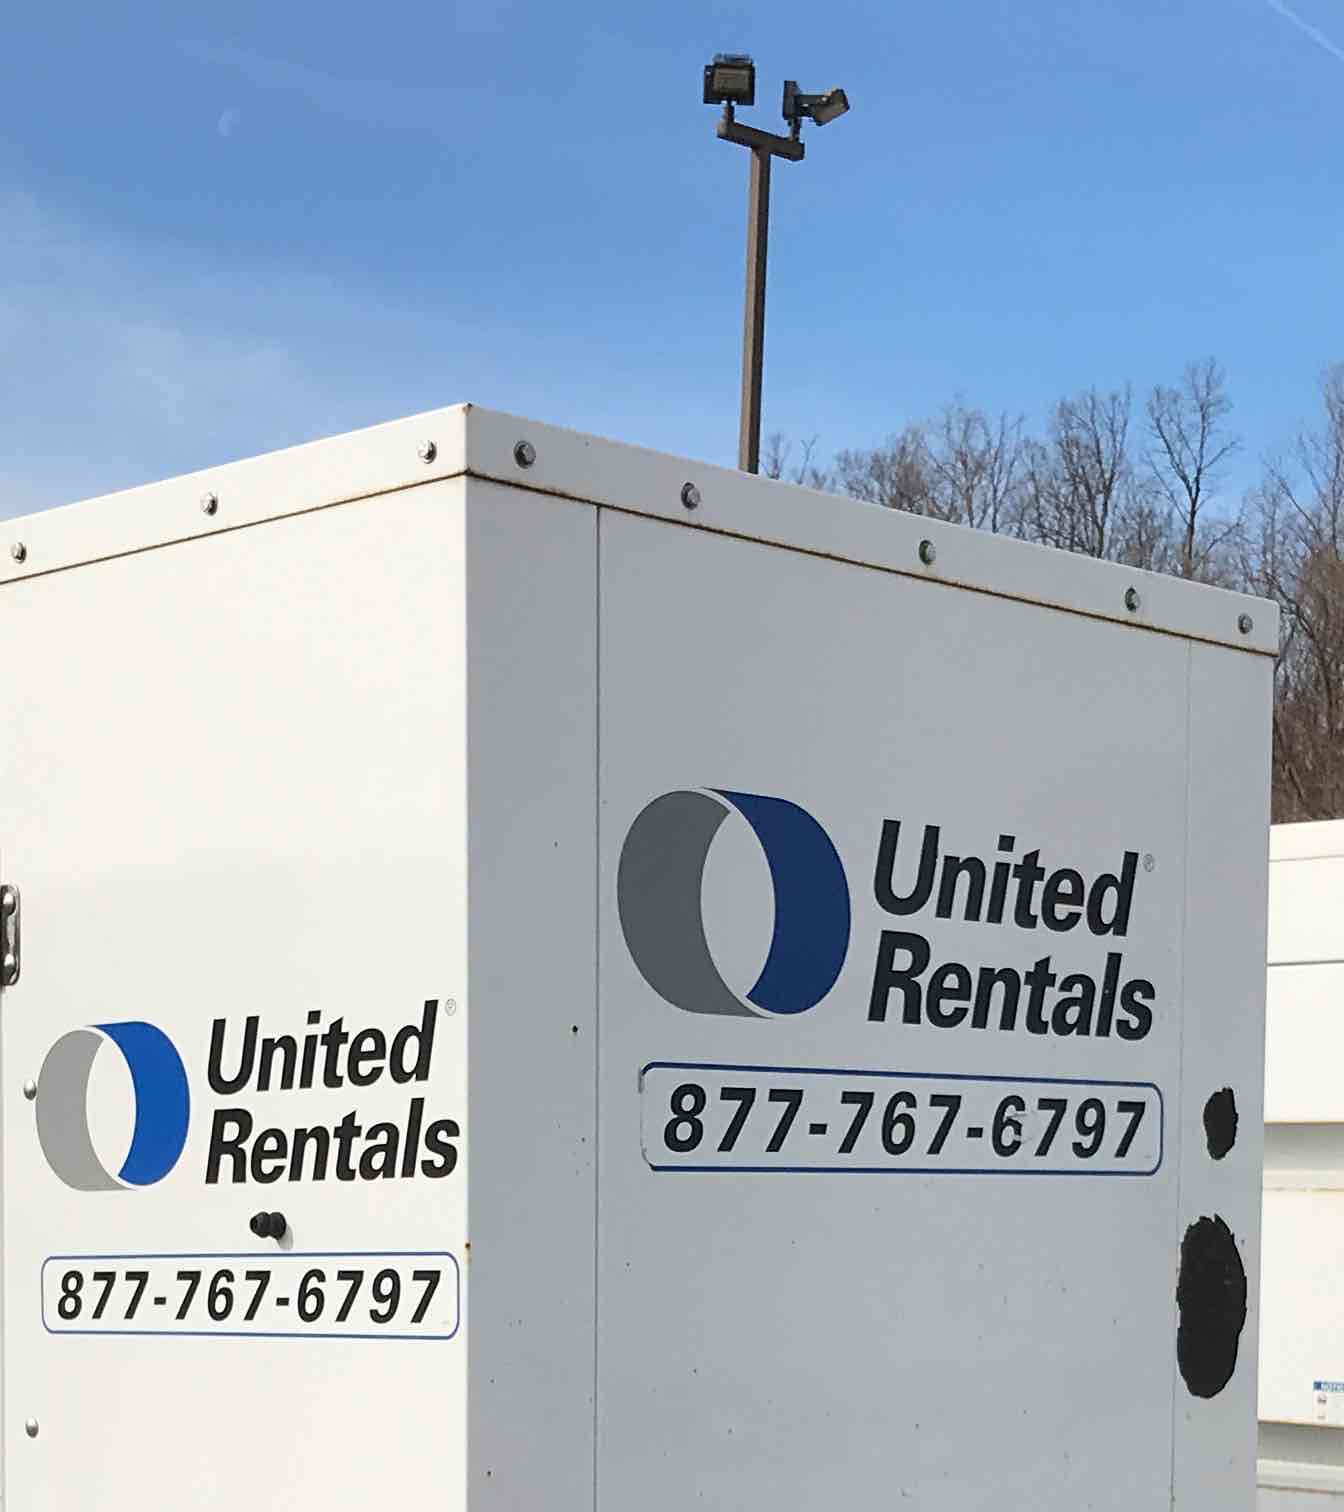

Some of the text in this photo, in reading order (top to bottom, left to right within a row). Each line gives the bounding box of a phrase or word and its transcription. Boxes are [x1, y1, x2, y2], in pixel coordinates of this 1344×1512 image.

[873, 818, 1140, 937] United
[867, 929, 1156, 1041] Rentals
[207, 999, 439, 1095] United
[205, 1097, 460, 1184] Rentals
[663, 1083, 1146, 1159] 877-767-6797
[57, 1267, 441, 1324] 877-767-6797
